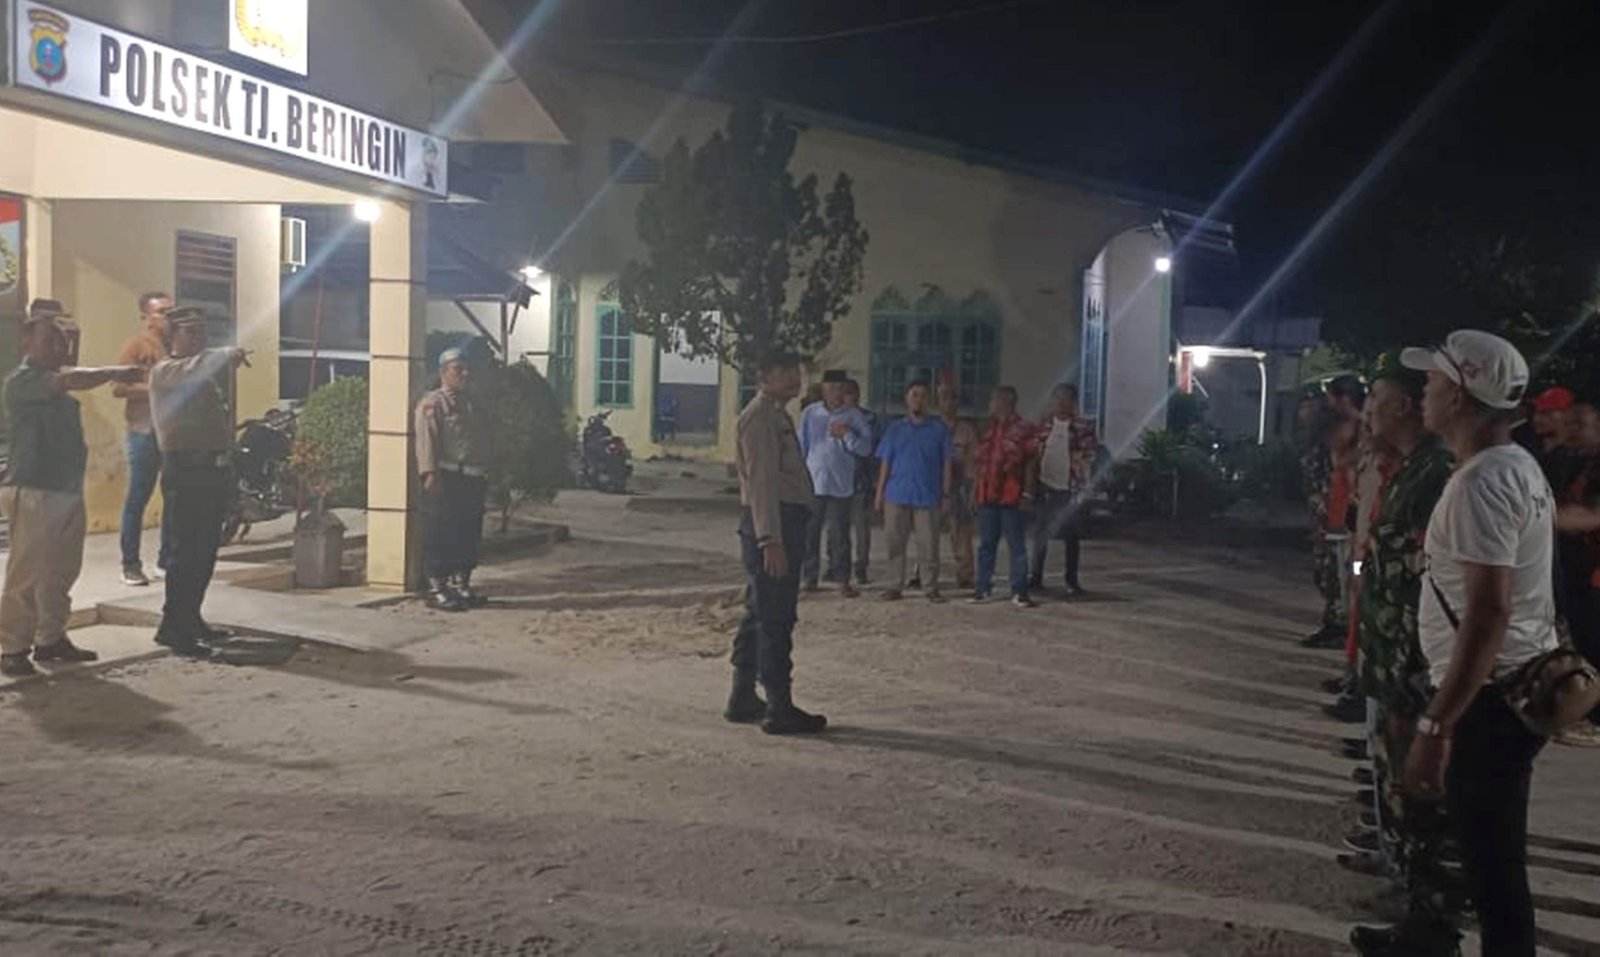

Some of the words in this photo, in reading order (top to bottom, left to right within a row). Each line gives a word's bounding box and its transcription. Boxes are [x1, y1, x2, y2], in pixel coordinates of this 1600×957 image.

[100, 34, 230, 130] POLSEK
[242, 79, 278, 143] TJ.
[287, 95, 406, 179] BERINGIN
